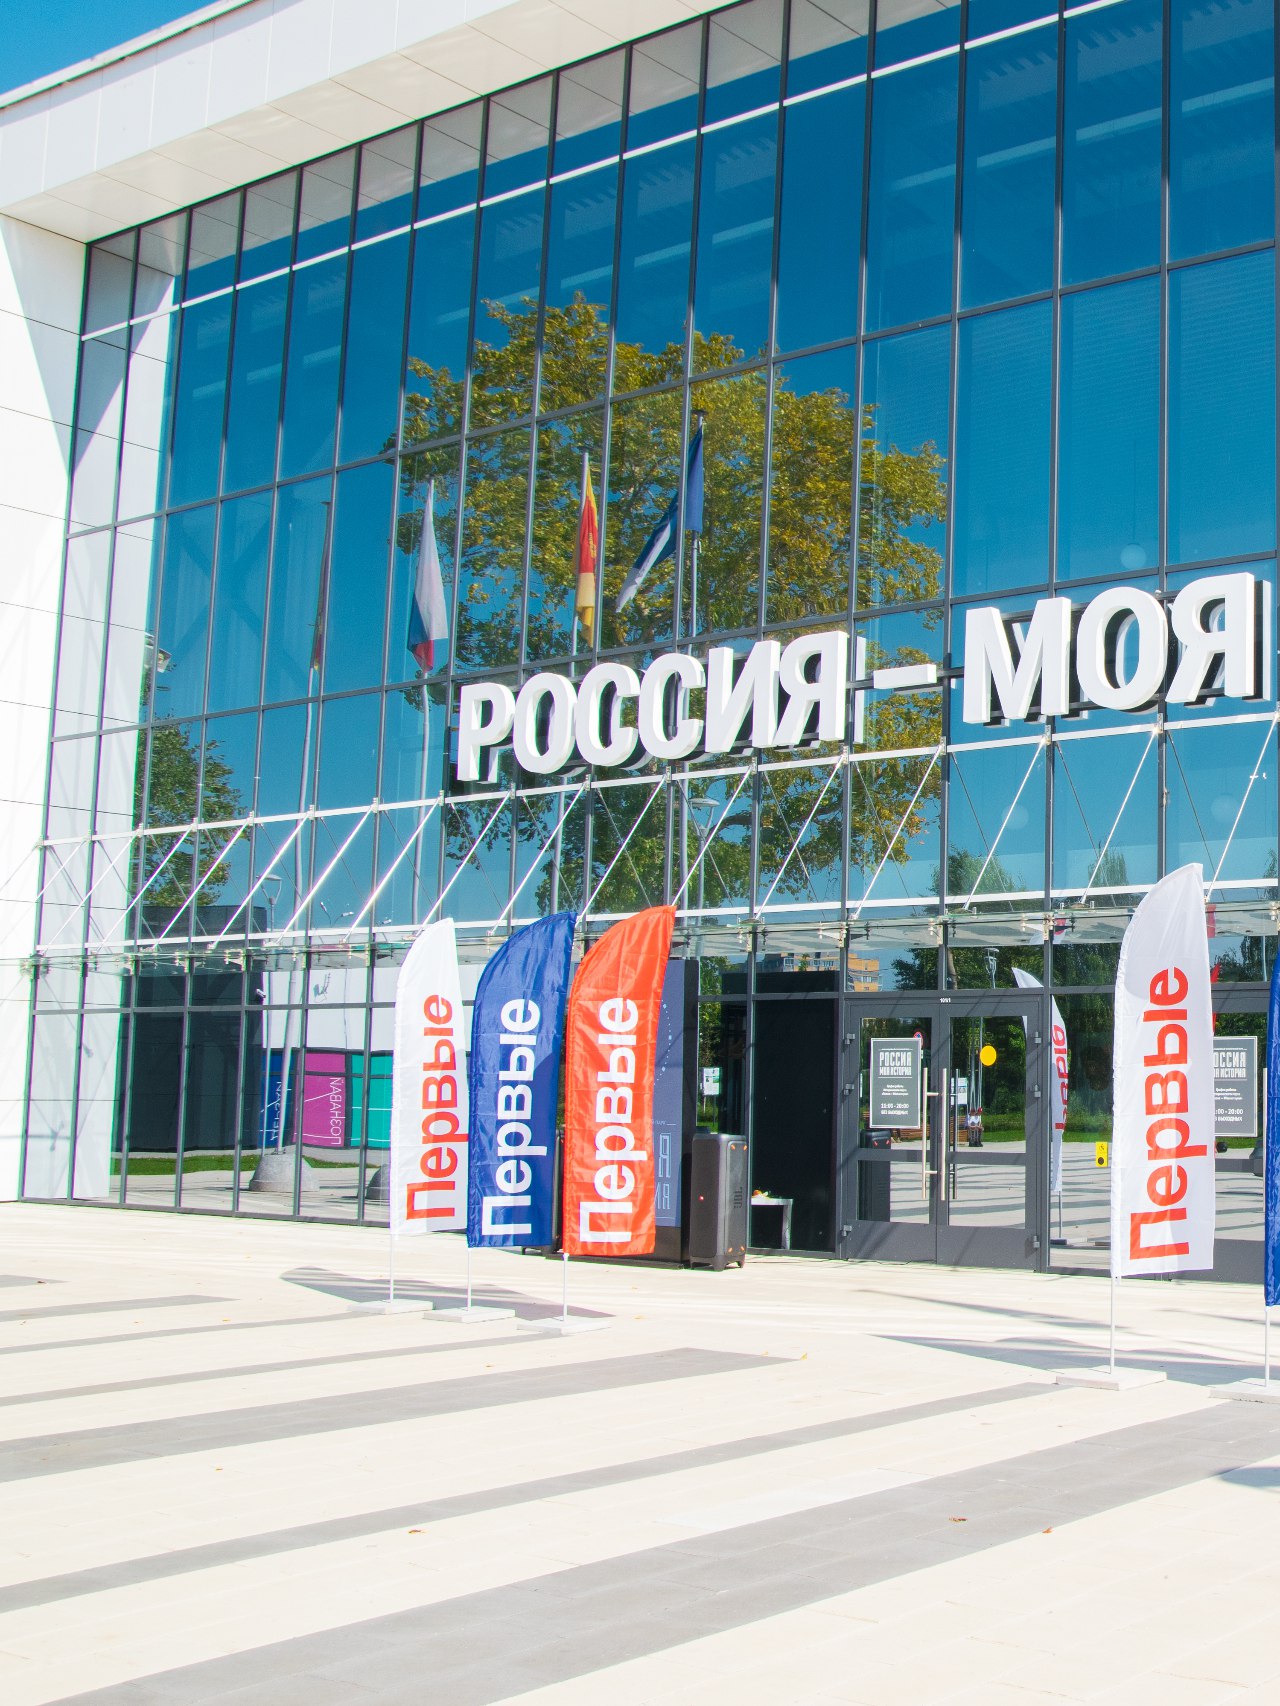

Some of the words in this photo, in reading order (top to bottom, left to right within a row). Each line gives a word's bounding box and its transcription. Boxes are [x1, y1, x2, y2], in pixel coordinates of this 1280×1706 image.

[456, 629, 848, 783] РОССИЯ
[962, 571, 1258, 725] МОЯ
[406, 993, 468, 1221] Первые
[481, 997, 549, 1237] Первые
[578, 996, 649, 1244] Первые
[879, 1052, 912, 1067] РОССИЯ
[1128, 965, 1209, 1261] Первые
[1213, 1051, 1247, 1068] ОССИЯ
